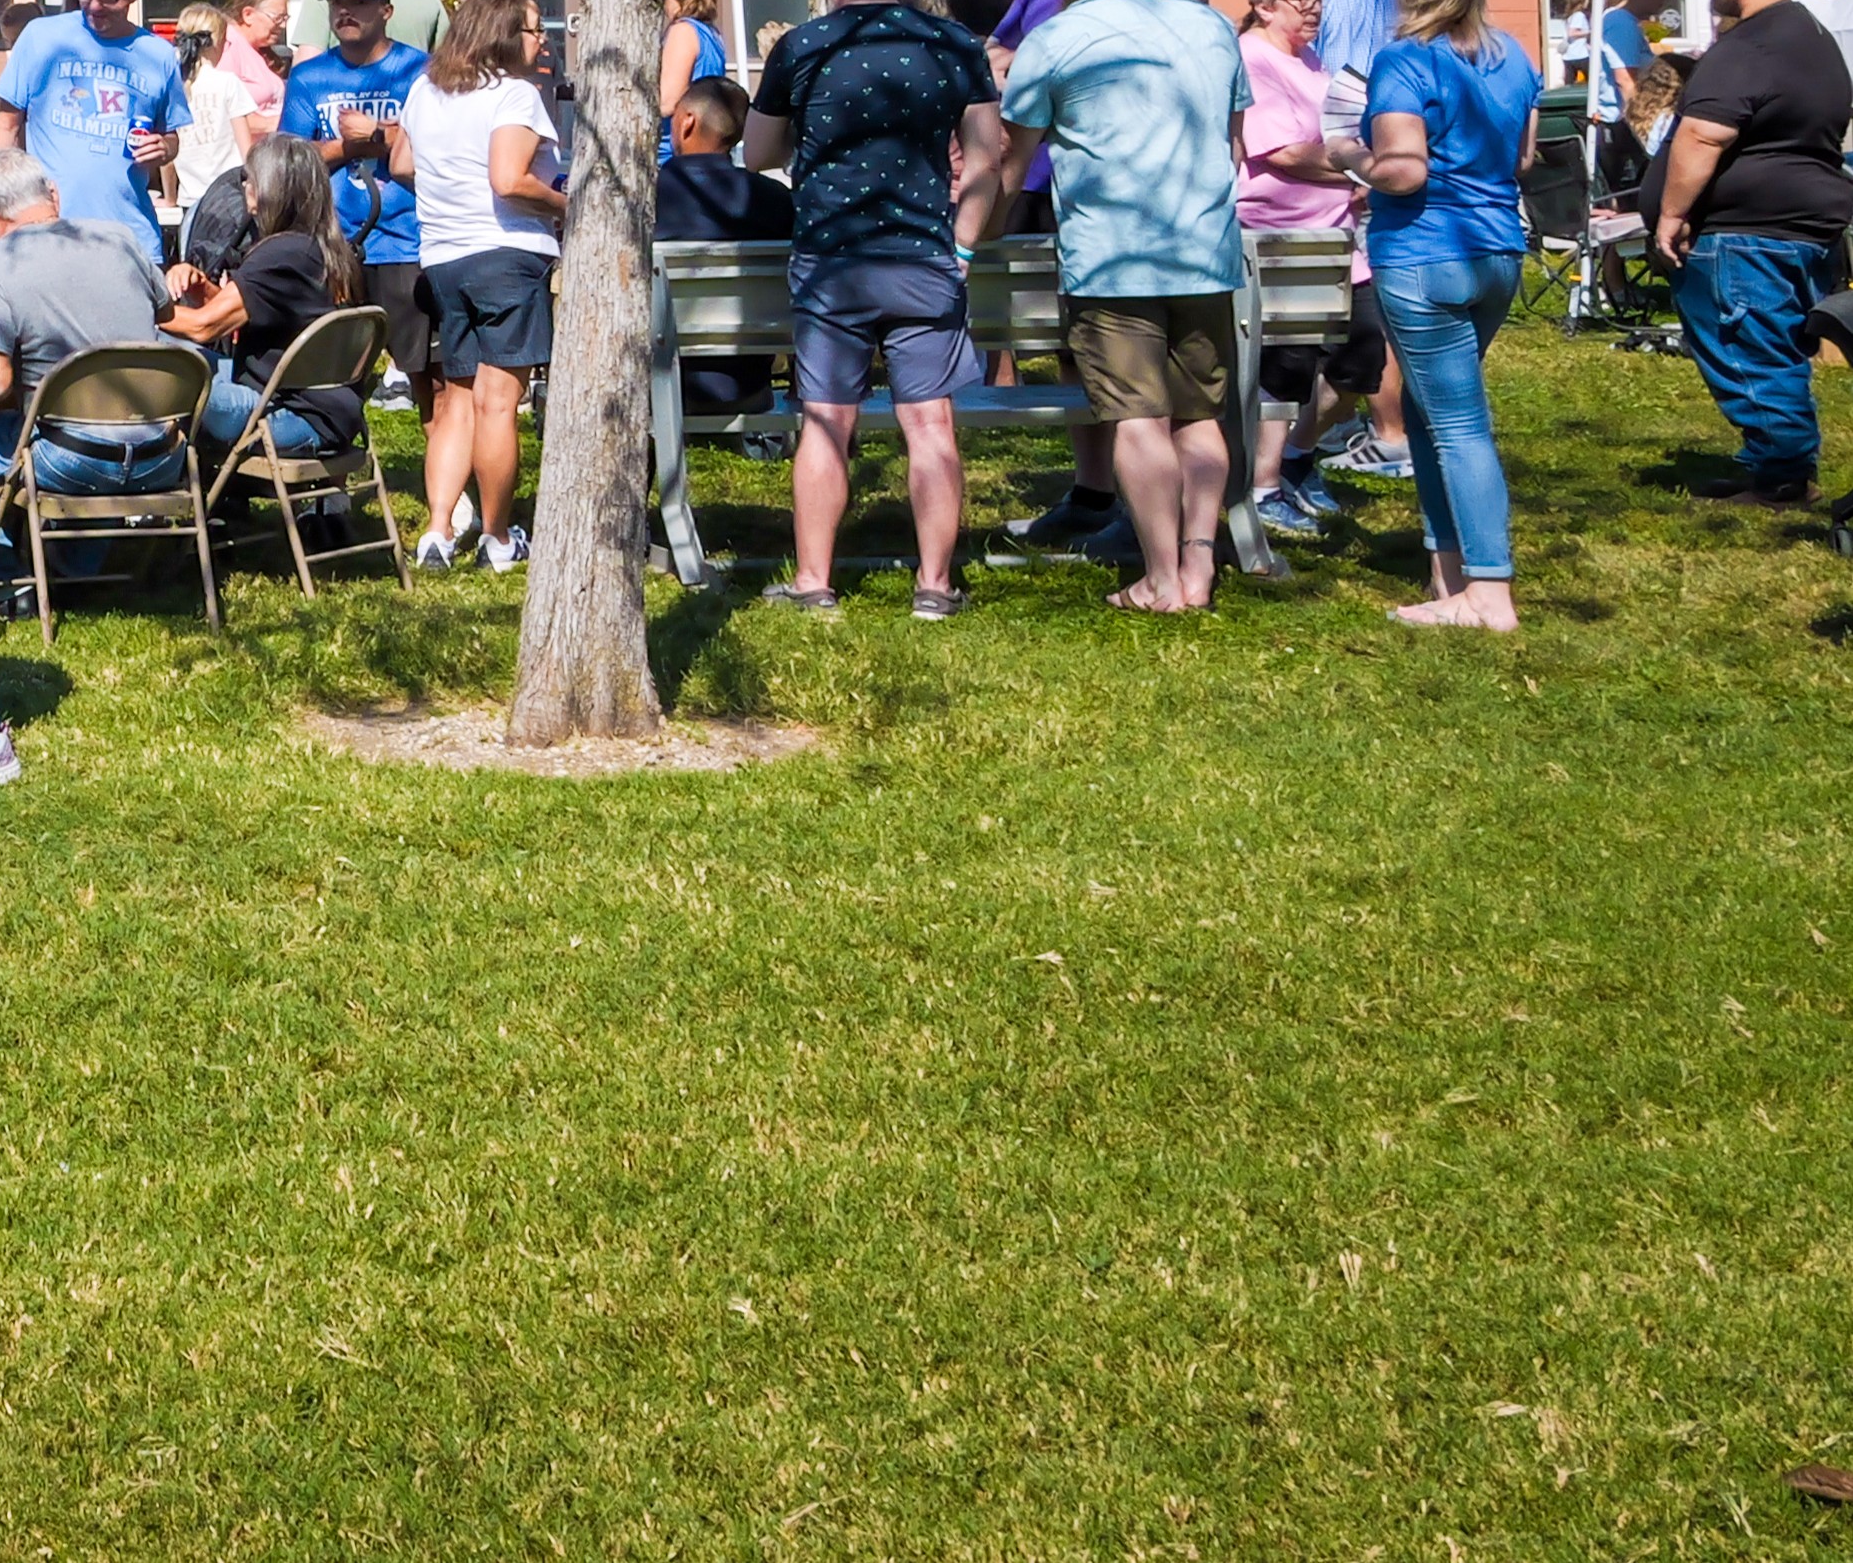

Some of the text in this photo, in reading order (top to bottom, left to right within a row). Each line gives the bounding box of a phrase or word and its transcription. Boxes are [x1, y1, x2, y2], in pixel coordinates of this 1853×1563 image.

[58, 60, 149, 95] NATIONAL
[98, 88, 126, 115] K
[51, 108, 129, 139] CHAMPIO
